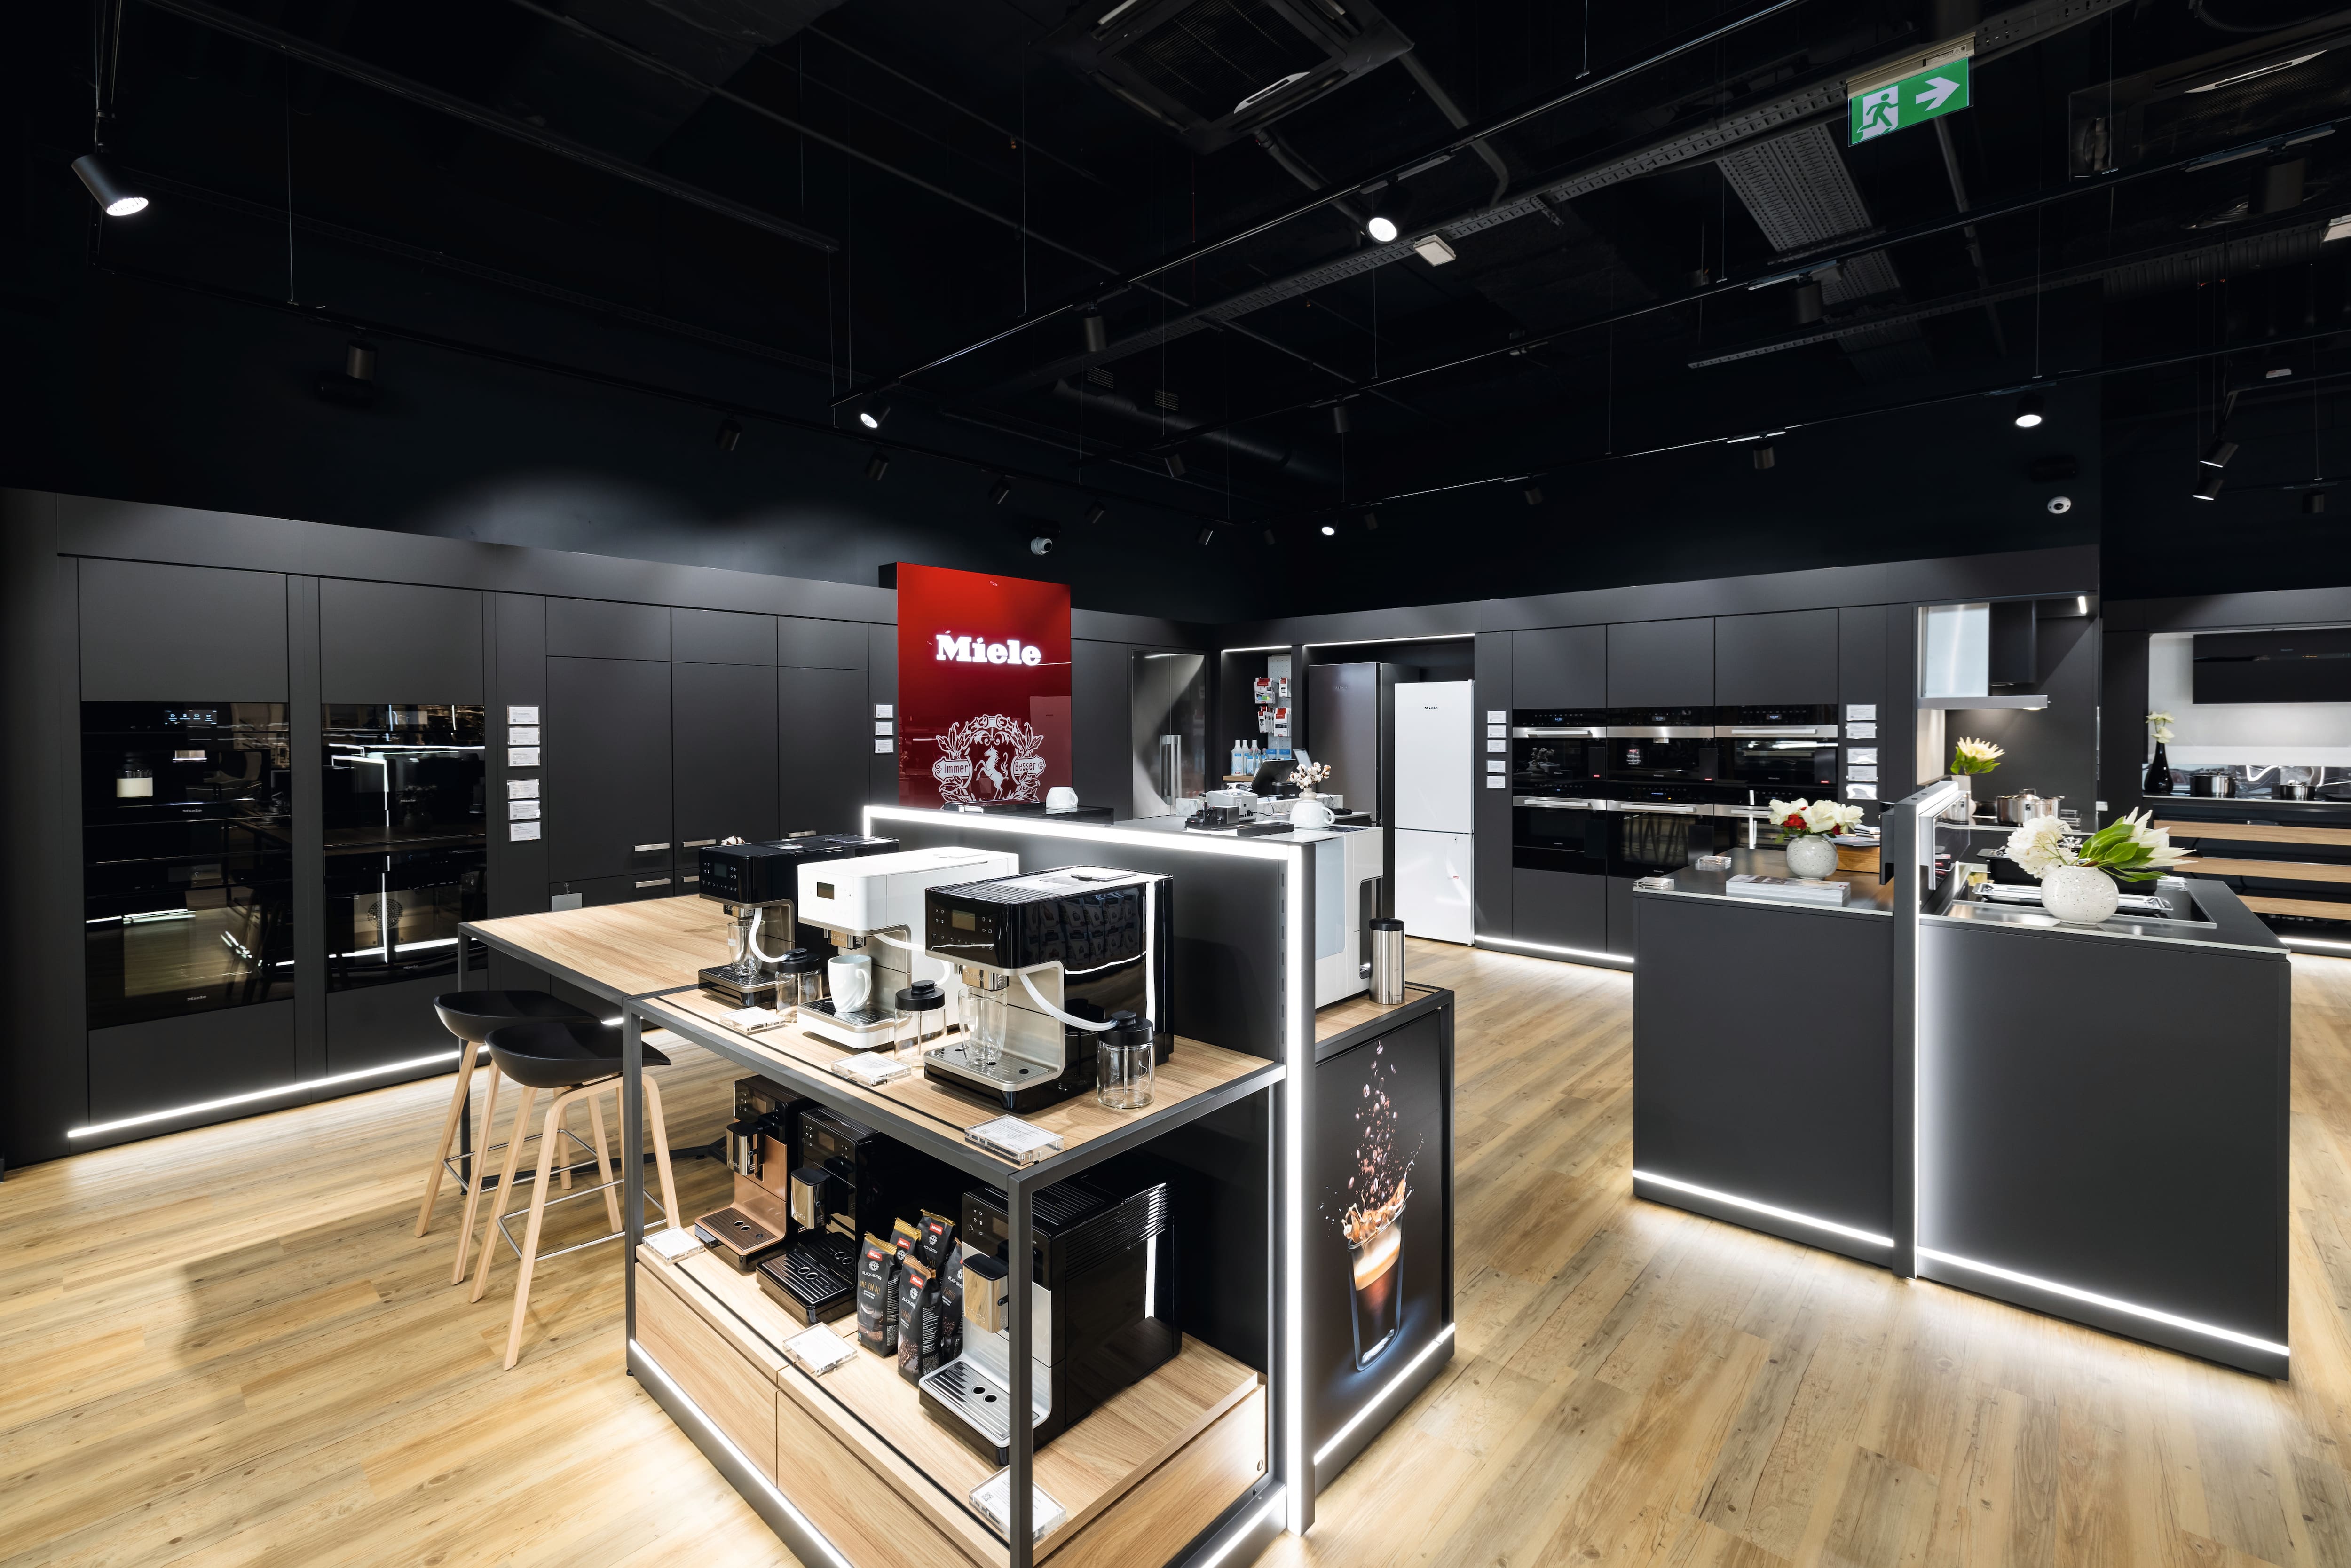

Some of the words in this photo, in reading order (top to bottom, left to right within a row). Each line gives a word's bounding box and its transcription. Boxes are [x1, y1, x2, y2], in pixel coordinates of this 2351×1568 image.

[936, 634, 1041, 666] Miele
[944, 764, 968, 774] Immer
[1015, 762, 1036, 771] Besser
[912, 1276, 922, 1285] Miele
[947, 1276, 956, 1284] BLACK
